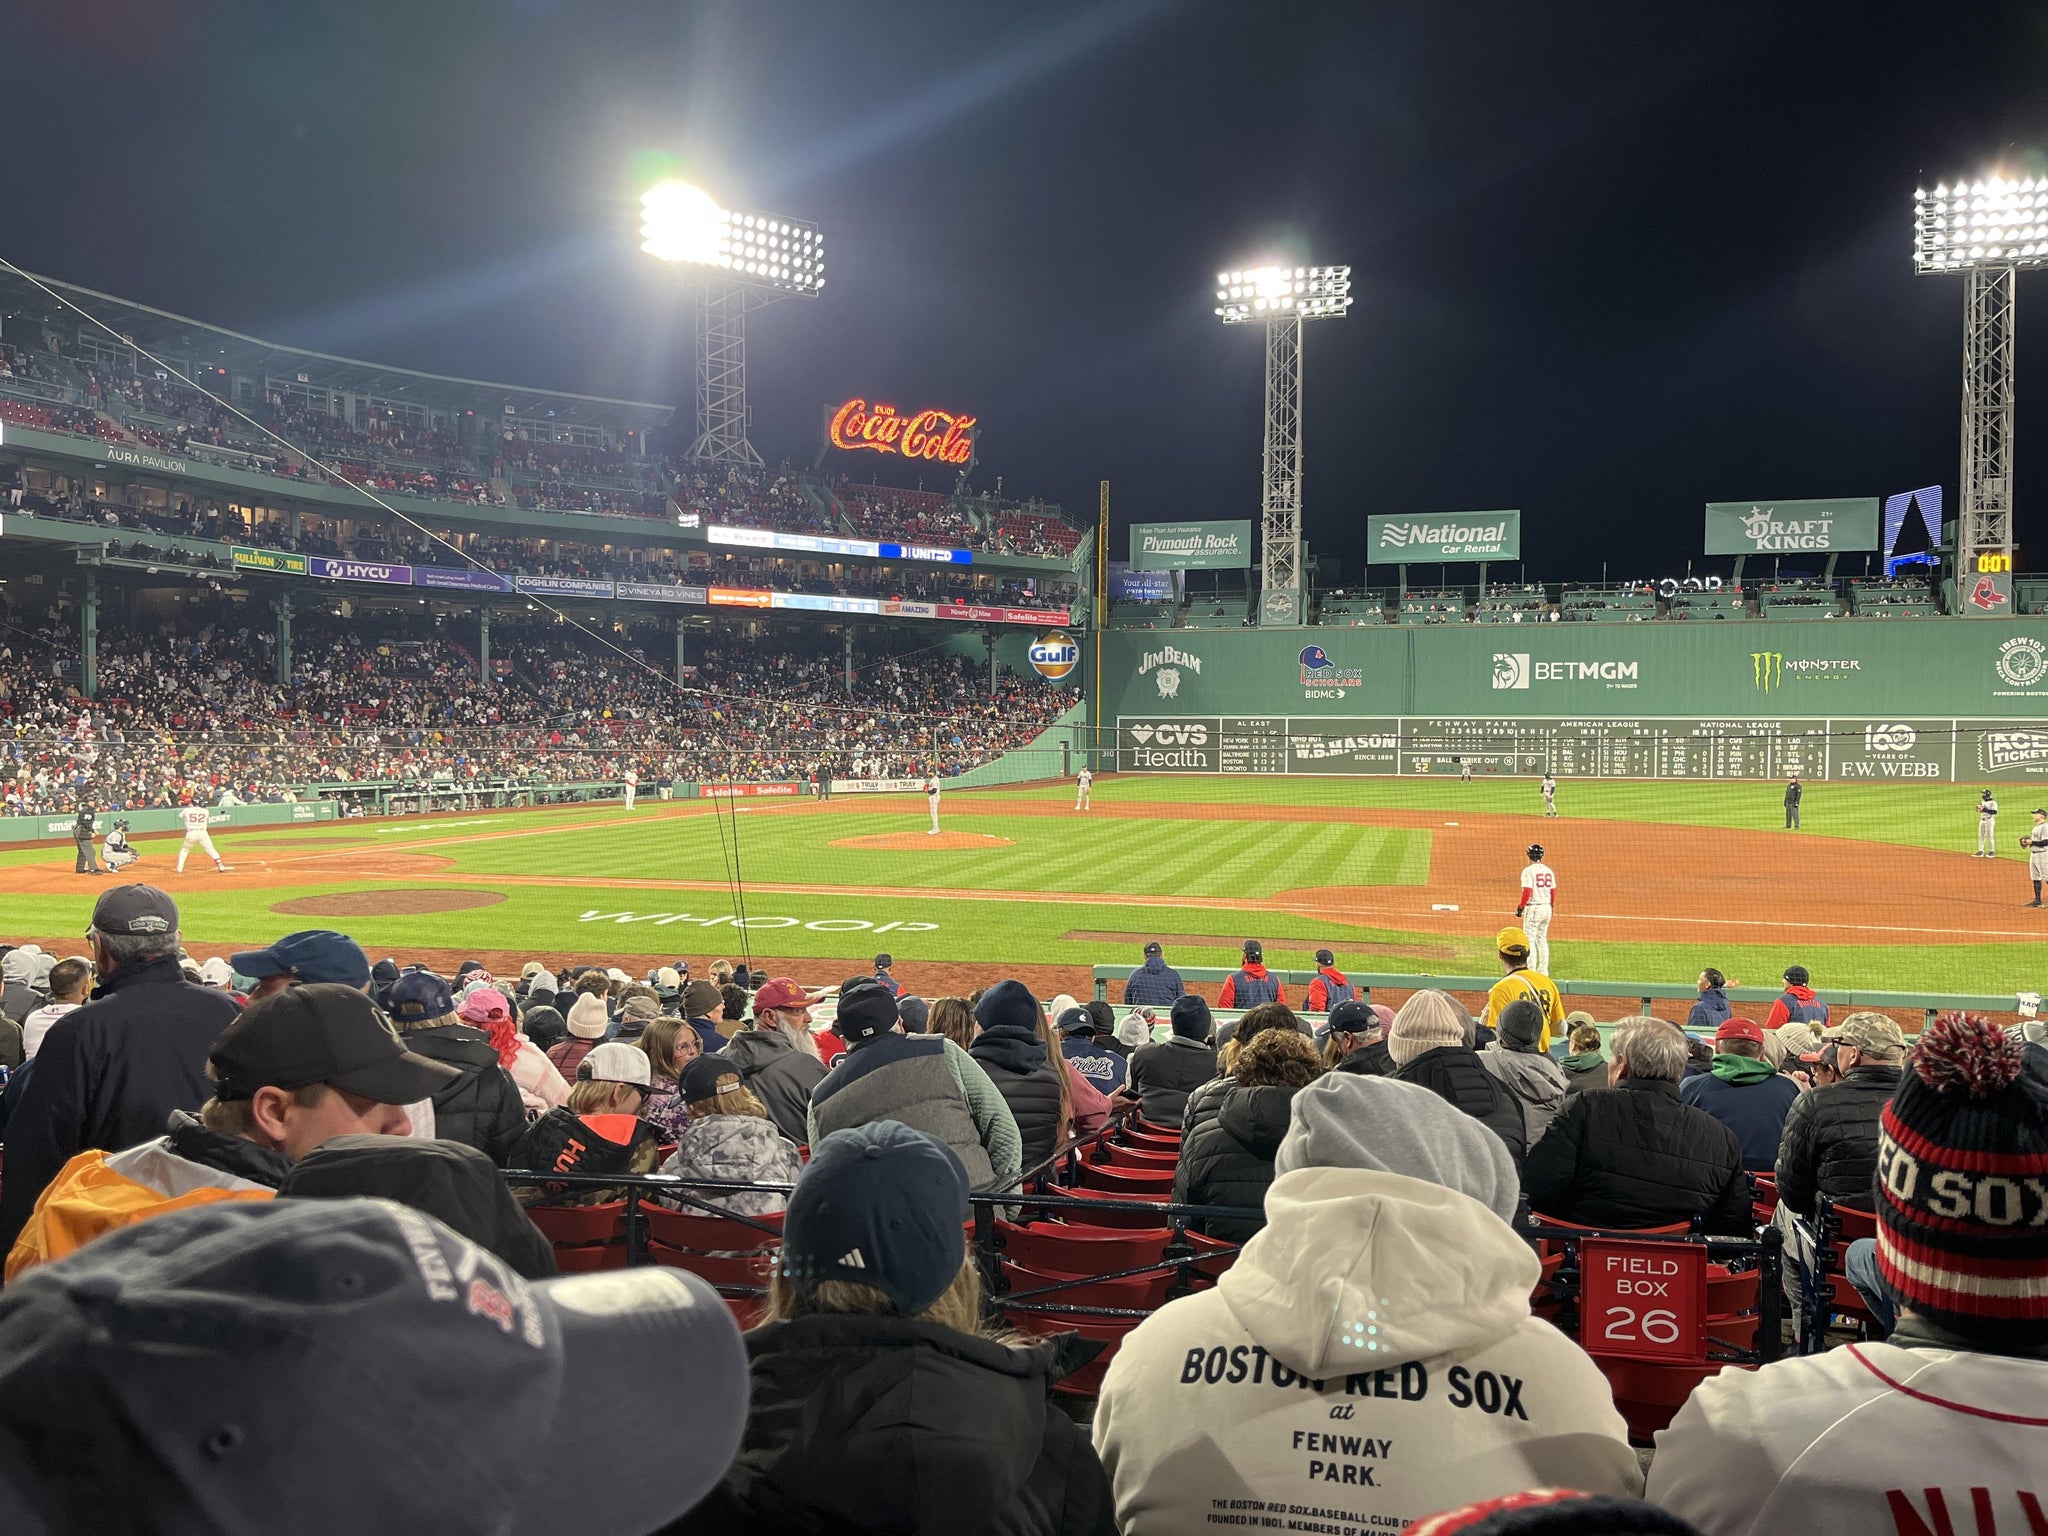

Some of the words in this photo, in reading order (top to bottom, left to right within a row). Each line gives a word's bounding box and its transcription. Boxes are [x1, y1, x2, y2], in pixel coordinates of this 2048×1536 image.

[874, 405, 896, 415] ENJOY
[831, 400, 976, 464] Coca-Cola
[142, 455, 186, 473] PAVILION
[1408, 522, 1506, 544] National
[1745, 519, 1833, 539] DRAFT
[1142, 535, 1202, 551] Plymouth
[1205, 533, 1238, 548] Rock
[1441, 545, 1460, 554] Car
[1464, 544, 1500, 553] Rental
[1756, 535, 1830, 550] KINGS
[234, 552, 275, 567] SULLIVAN
[286, 559, 304, 571] TIRE
[911, 547, 953, 561] UNITED
[1978, 554, 2010, 573] 0:07
[347, 565, 391, 579] HYCU
[518, 578, 559, 588] COGHLIN
[559, 580, 614, 591] COMPANIES
[1123, 578, 1140, 587] Your
[628, 588, 676, 597] VINEYARD
[677, 590, 703, 599] VINES
[950, 608, 969, 618] Ninety
[978, 610, 992, 618] Nine
[1007, 612, 1038, 622] Safelite
[1998, 637, 2028, 653] IBEW
[2028, 638, 2046, 653] 103
[1031, 647, 1076, 662] Gulf
[1535, 661, 1638, 680] BETMGM
[1785, 659, 1861, 672] MONSTER
[1305, 669, 1332, 678] RED
[1335, 669, 1362, 678] SOX
[1305, 678, 1362, 687] SCHOLARS
[1305, 690, 1335, 698] BIDMC
[1155, 724, 1208, 745] CVS
[1865, 724, 1916, 751] 160
[1993, 733, 2048, 751] ACE
[1133, 747, 1208, 767] Health
[1994, 750, 2048, 764] TICKET
[1415, 762, 1429, 773] 52
[1840, 762, 1875, 777] F.W.
[1881, 762, 1940, 777] WEBB
[756, 786, 793, 795] Safelite
[189, 813, 206, 823] 52
[209, 814, 231, 824] ICKET
[1535, 873, 1553, 888] 58
[577, 910, 940, 934] WHOOP
[1797, 999, 1822, 1008] BOSTON
[1878, 1115, 1920, 1200] ED
[1606, 1256, 1679, 1276] FIELD
[1617, 1279, 1668, 1297] BOX
[1605, 1306, 1680, 1344] 26
[1345, 1360, 1428, 1401] RED
[1447, 1365, 1530, 1421] SOX
[1329, 1403, 1355, 1421] at
[1293, 1430, 1393, 1459] FENWAY
[1212, 1499, 1228, 1509] THE
[1230, 1500, 1265, 1511] BOSTON
[1267, 1502, 1287, 1513] RED
[1311, 1507, 1368, 1524] BASEBALL
[1371, 1514, 1399, 1528] CLUB
[1207, 1513, 1248, 1525] FOUNDED
[1249, 1516, 1259, 1525] IN
[1260, 1516, 1286, 1529] 1901.
[1288, 1519, 1336, 1534] MEMBERS
[1338, 1524, 1357, 1536] OF
